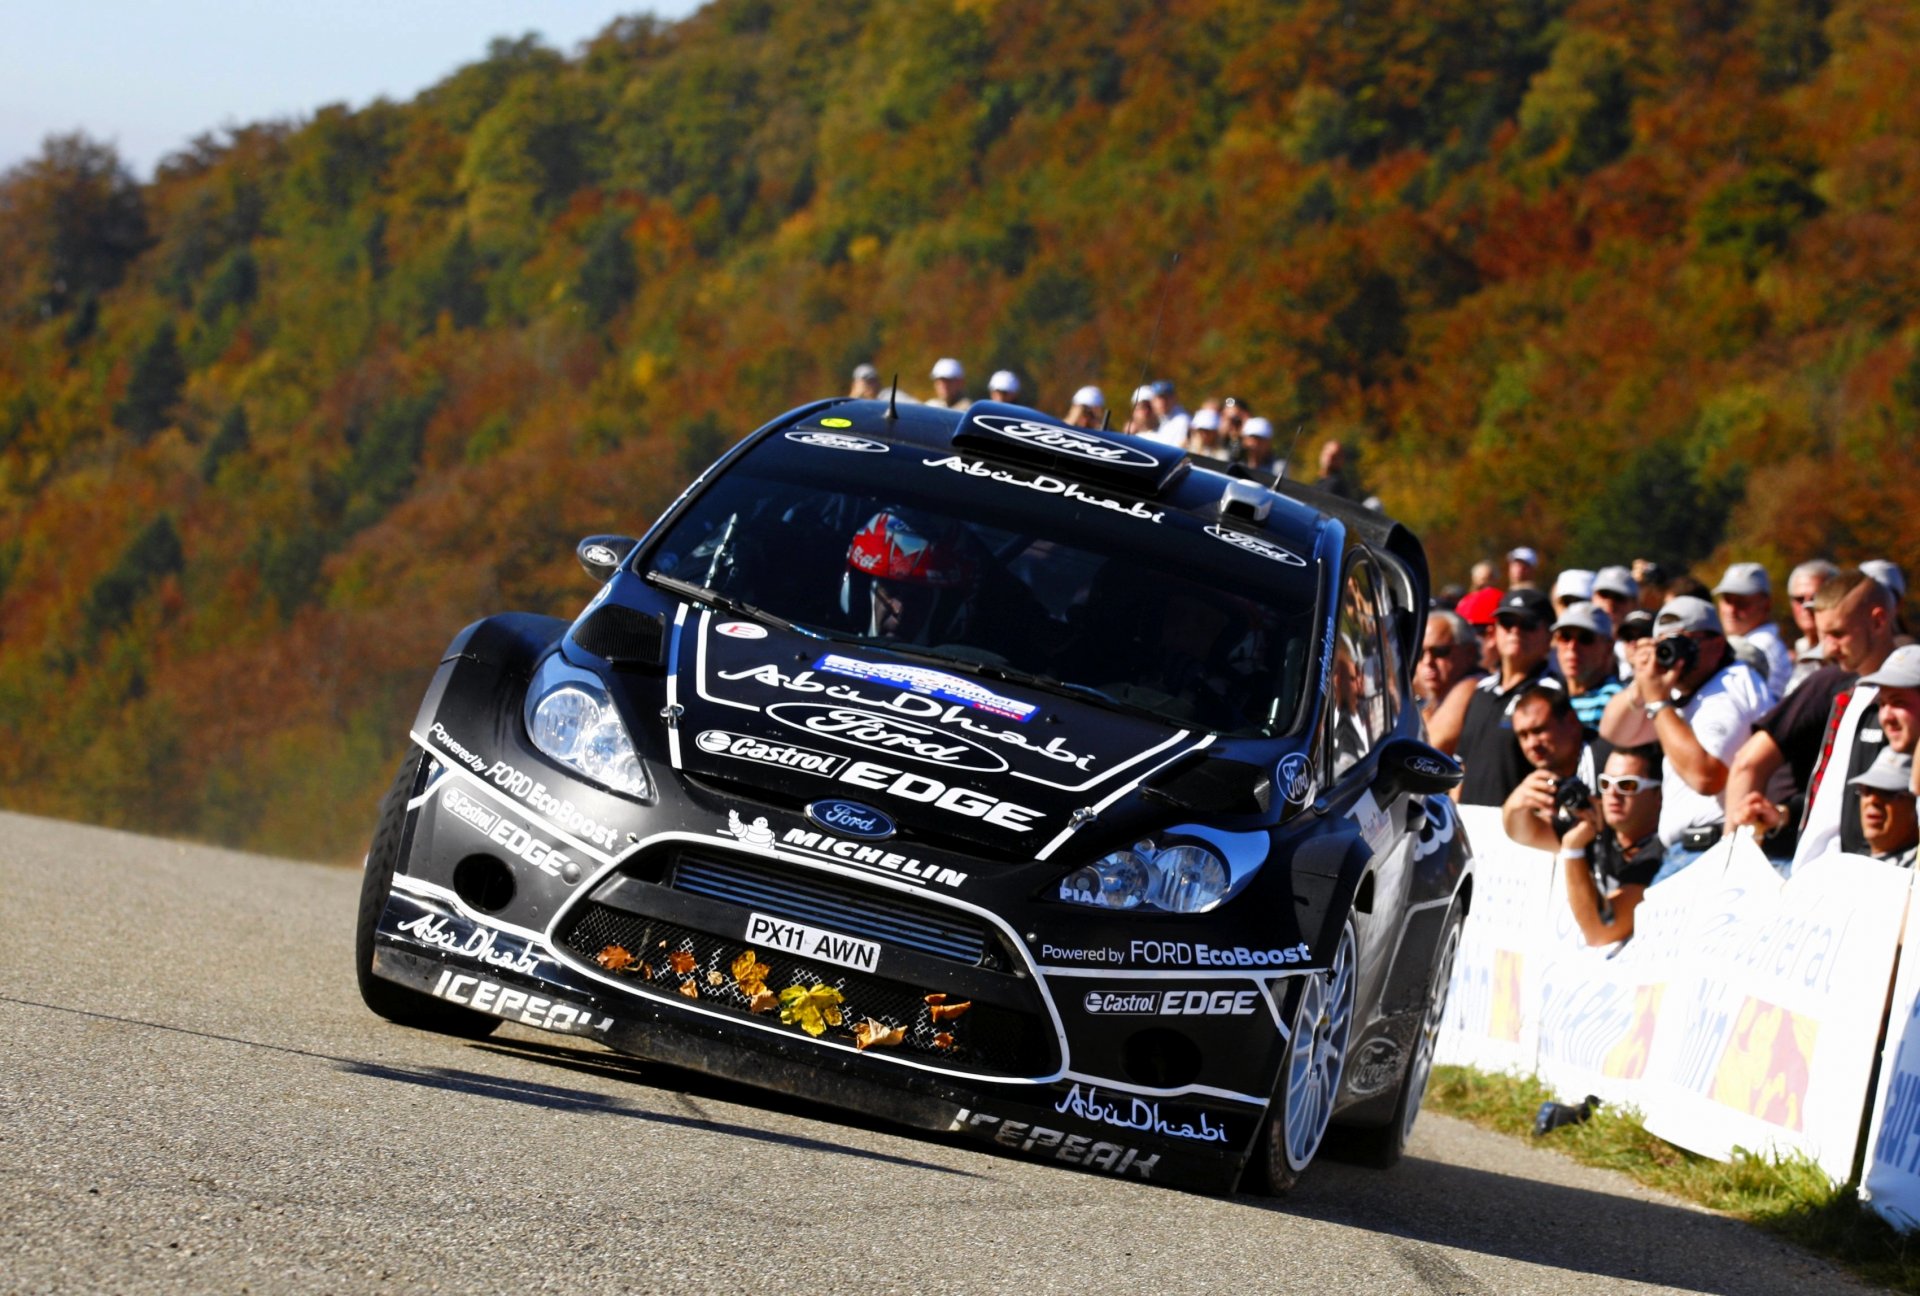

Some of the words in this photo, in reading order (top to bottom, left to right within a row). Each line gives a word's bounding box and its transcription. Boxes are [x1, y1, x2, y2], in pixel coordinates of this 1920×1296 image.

[801, 432, 872, 450] Ford
[1004, 422, 1131, 461] Ford
[1221, 532, 1289, 560] Ford
[805, 709, 969, 761] Ford
[730, 737, 838, 774] Castrol
[839, 761, 1047, 832] EDGE
[1283, 759, 1309, 799] Ford
[1413, 757, 1440, 775] Ford
[429, 722, 478, 764] Powered
[470, 757, 487, 772] by
[484, 761, 533, 797] FORD
[526, 782, 618, 850] EcoBoost
[825, 803, 876, 832] Ford
[454, 799, 496, 830] Castrol
[489, 819, 571, 877] EDGE
[783, 828, 968, 888] MICHELIN
[1060, 887, 1109, 906] PIAA
[752, 918, 805, 951] PX11
[813, 935, 875, 968] AWN
[1042, 944, 1106, 962] Powered
[1109, 947, 1125, 964] by
[1131, 940, 1192, 964] FORD
[1196, 942, 1312, 965] EcoBoost
[1102, 993, 1155, 1012] Castrol
[1159, 990, 1260, 1015] EDGE
